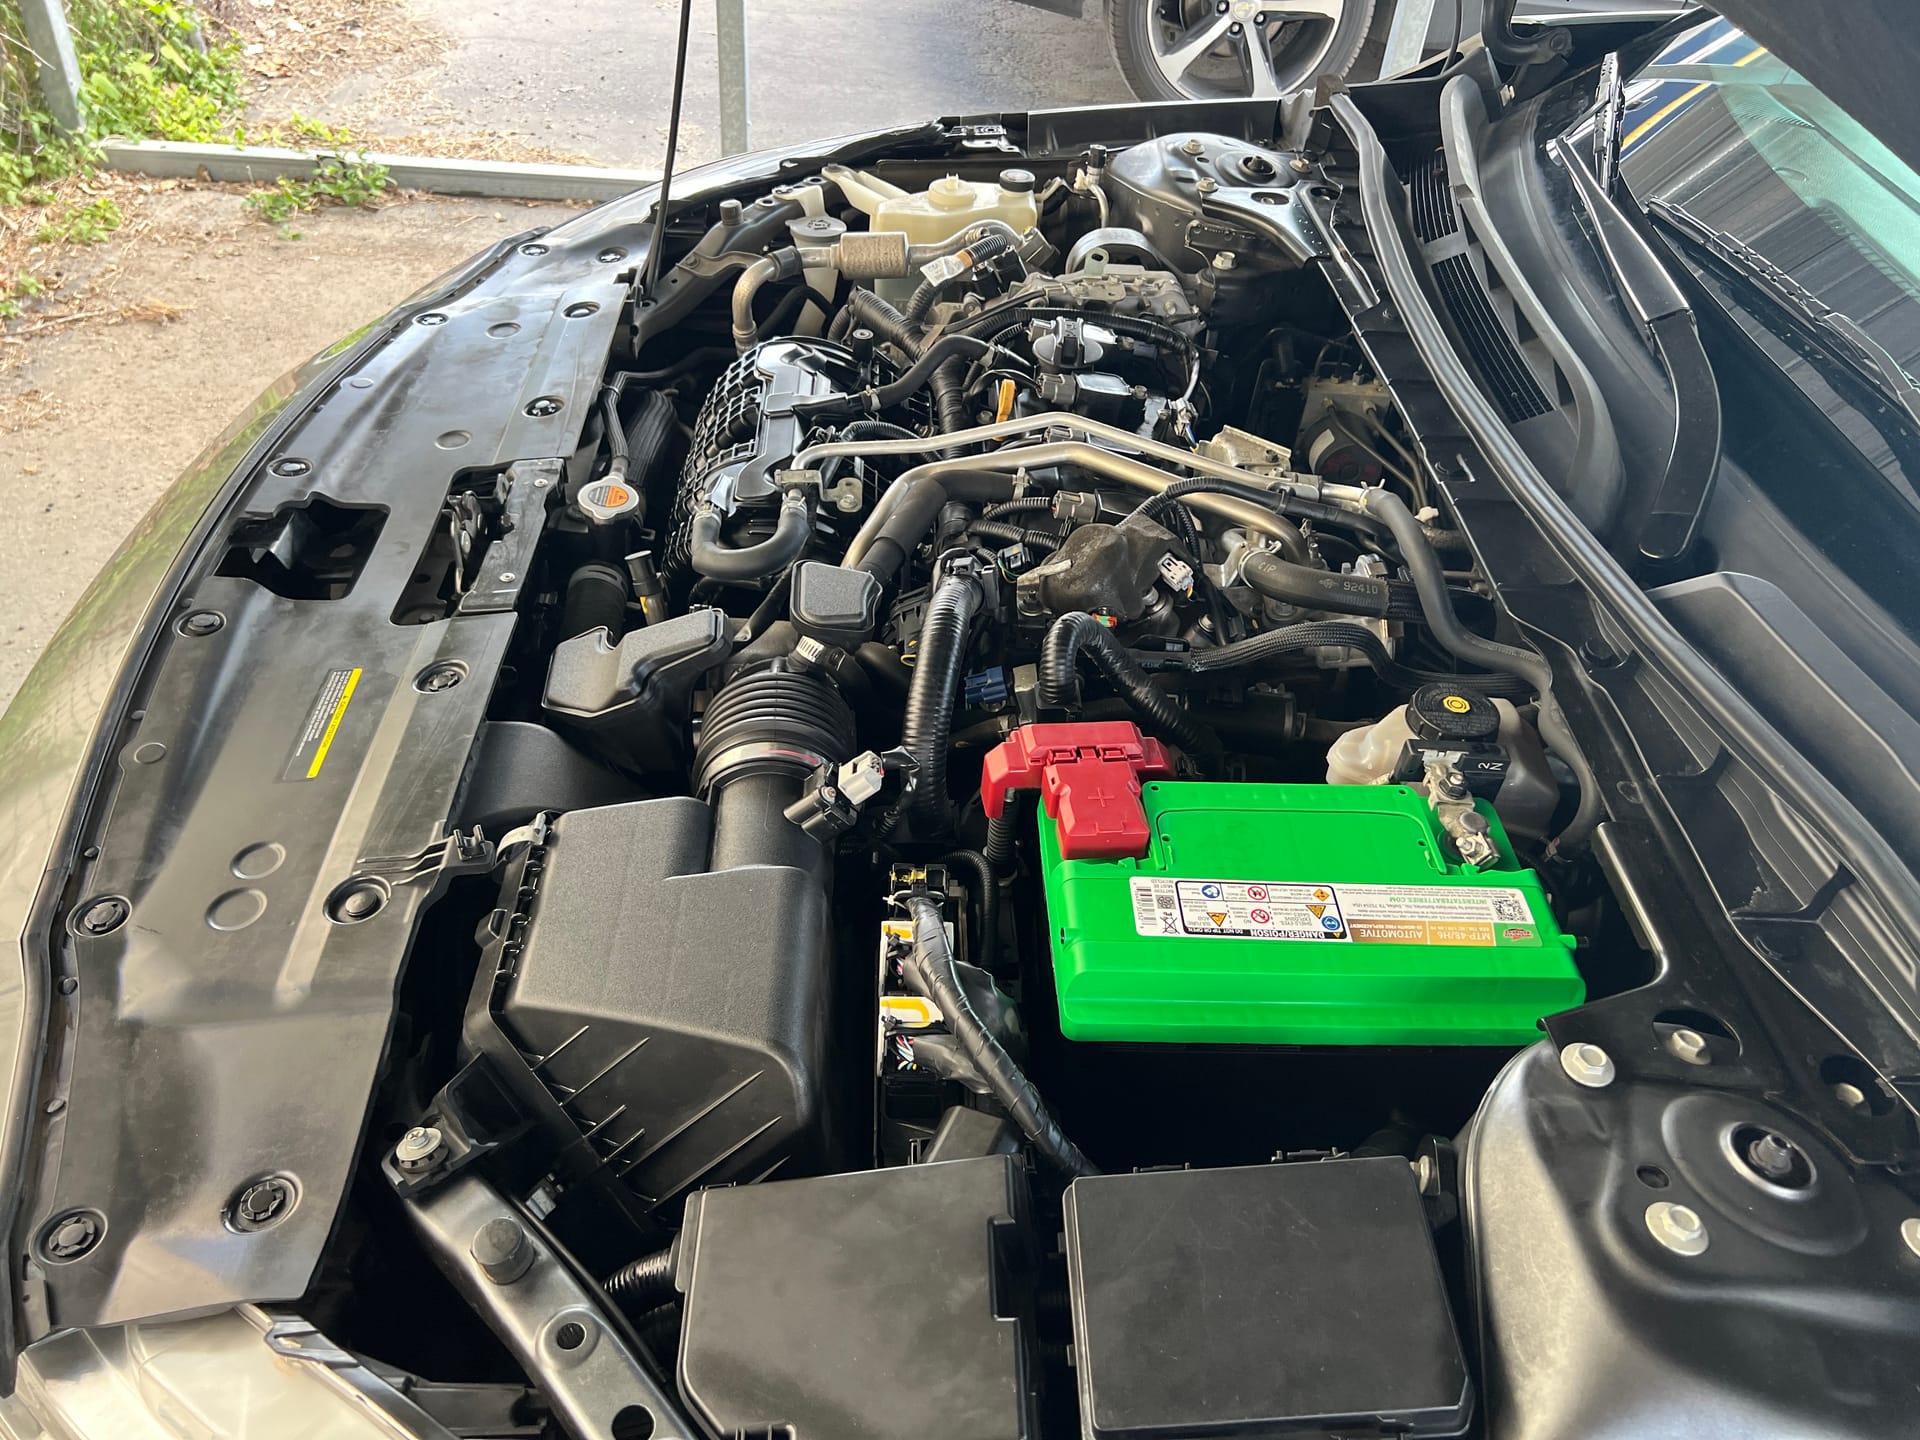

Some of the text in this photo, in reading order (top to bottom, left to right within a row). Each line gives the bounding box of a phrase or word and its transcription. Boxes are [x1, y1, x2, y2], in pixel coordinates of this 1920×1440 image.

[1343, 581, 1378, 595] 92410
[1249, 929, 1325, 938] DANGER/POISON
[1360, 929, 1422, 938] AUTOMOTIVE
[1438, 931, 1490, 940] MTP-48/H6
